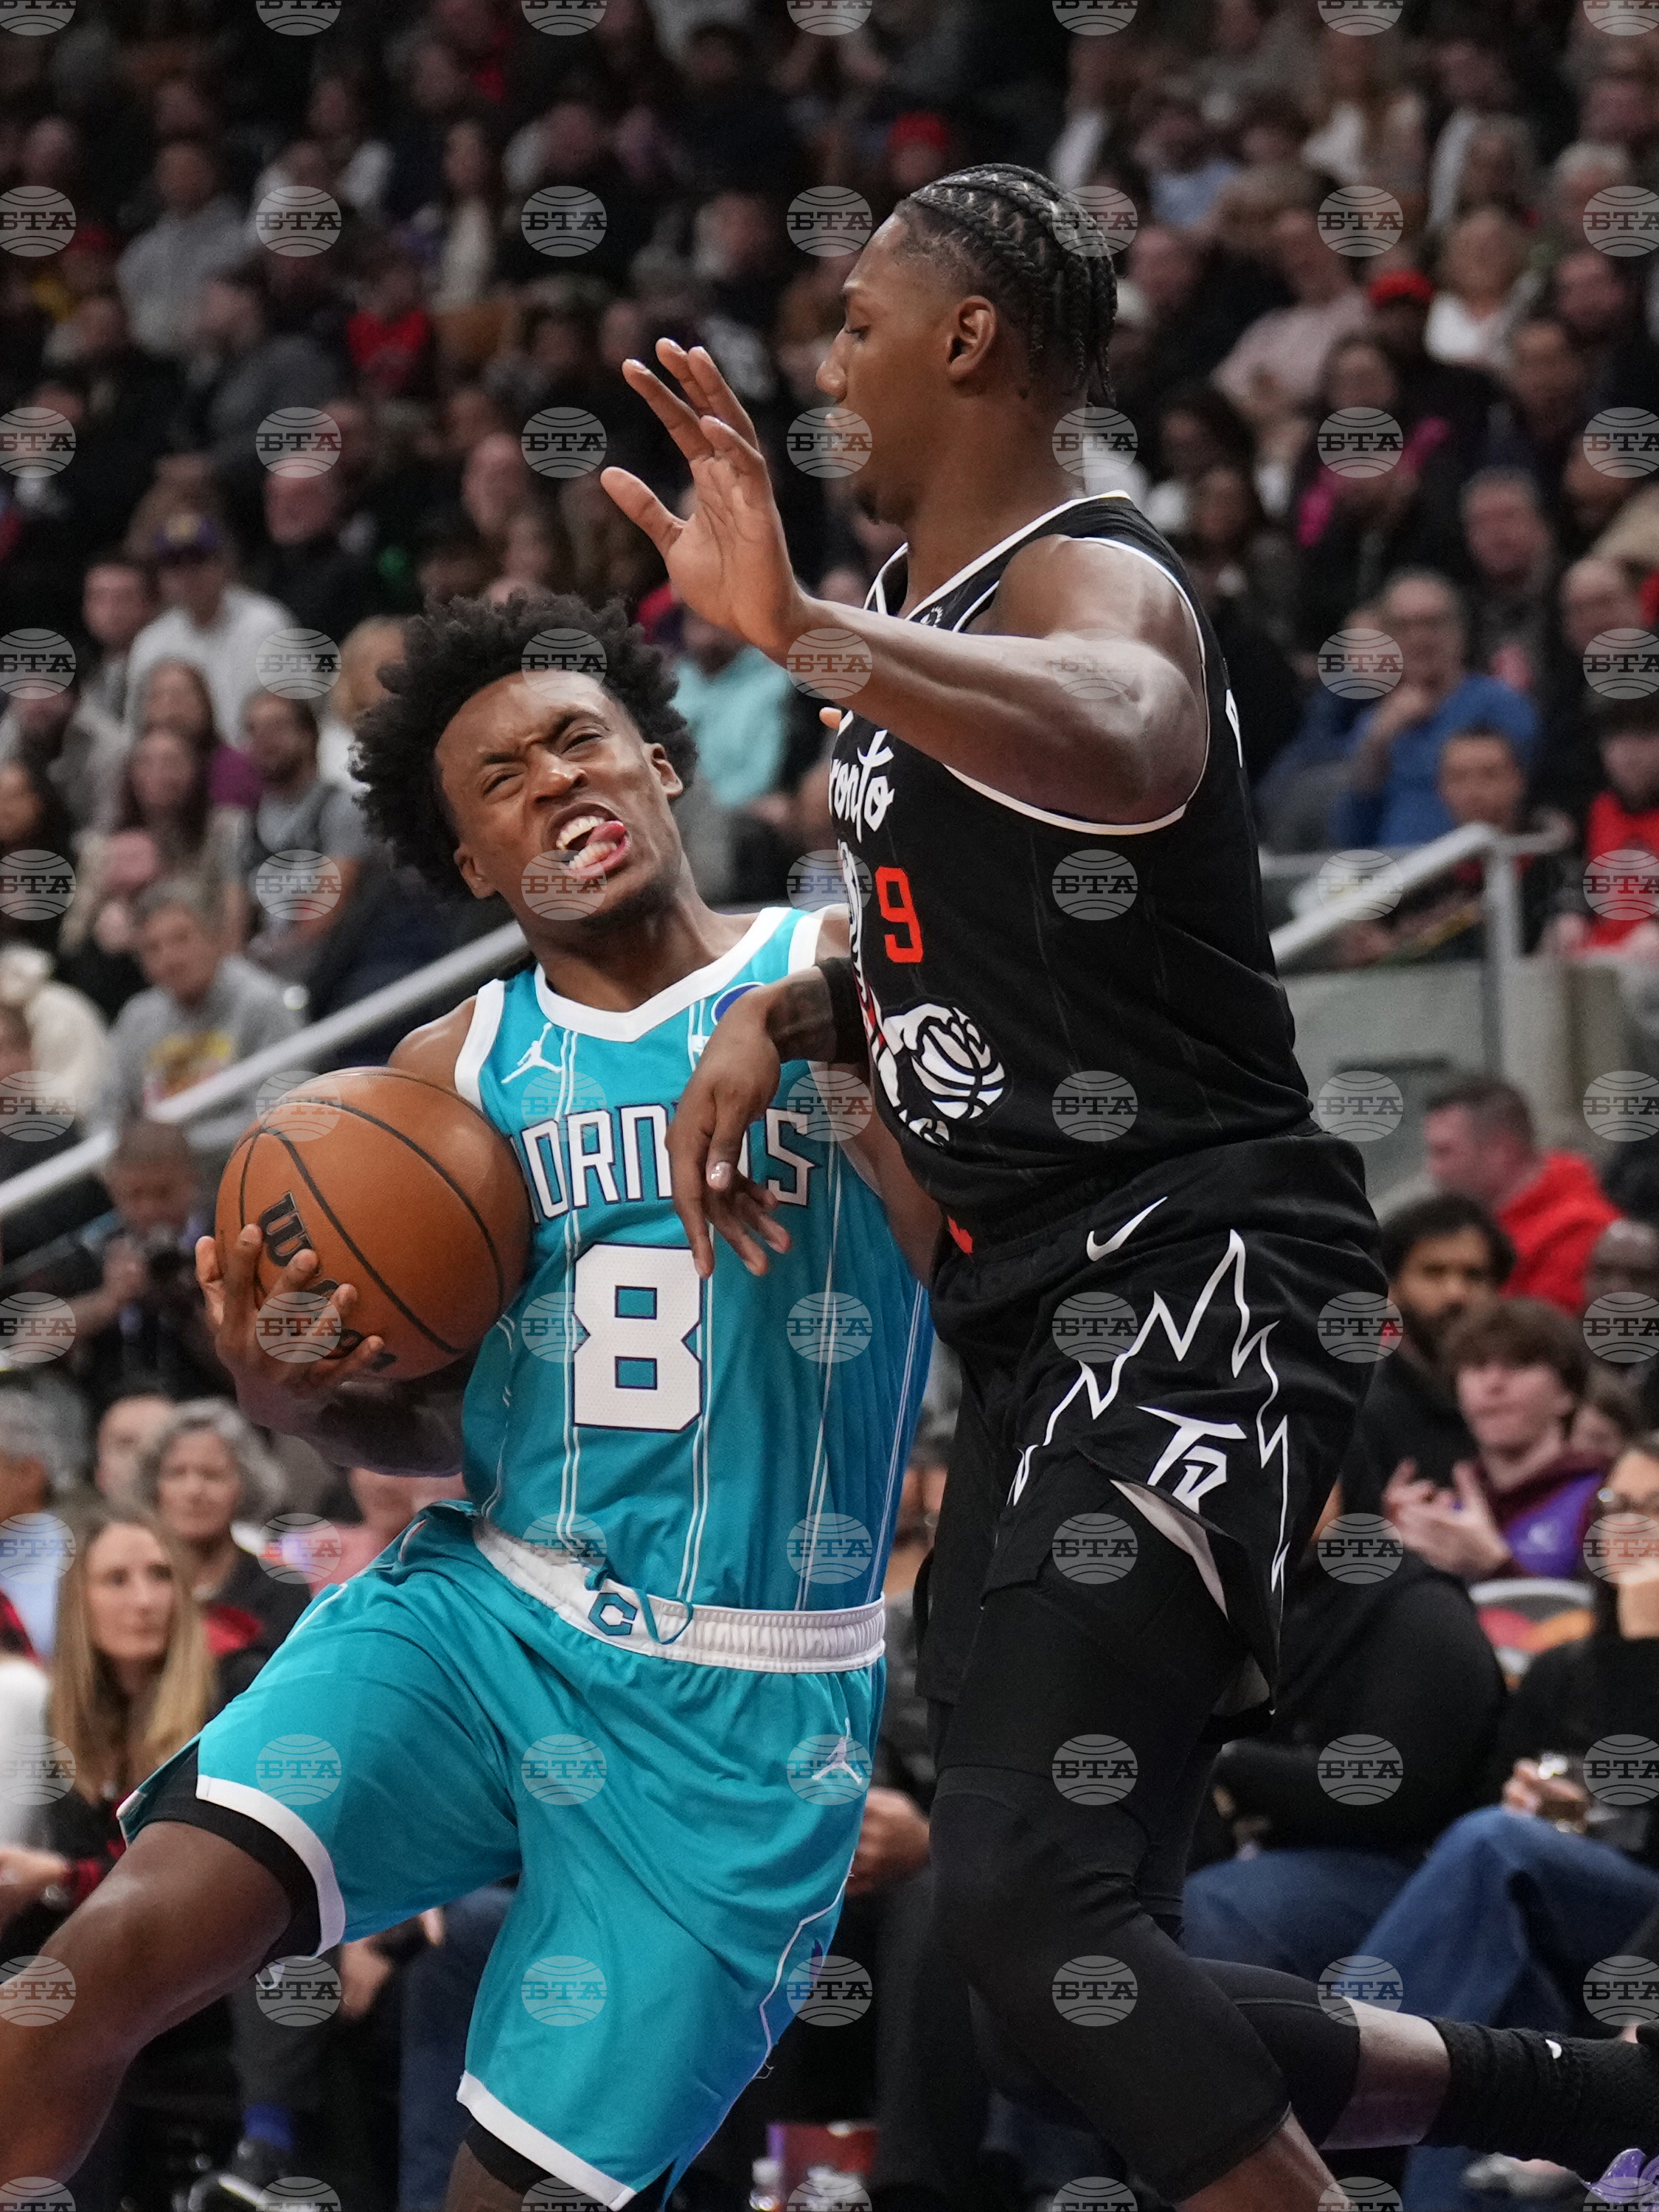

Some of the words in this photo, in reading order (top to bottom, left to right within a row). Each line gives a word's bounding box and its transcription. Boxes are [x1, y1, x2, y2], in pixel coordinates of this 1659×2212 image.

[829, 729, 895, 843] ronto
[875, 866, 924, 963] 9
[510, 1103, 821, 1225] ORNS
[573, 1241, 704, 1433] 8
